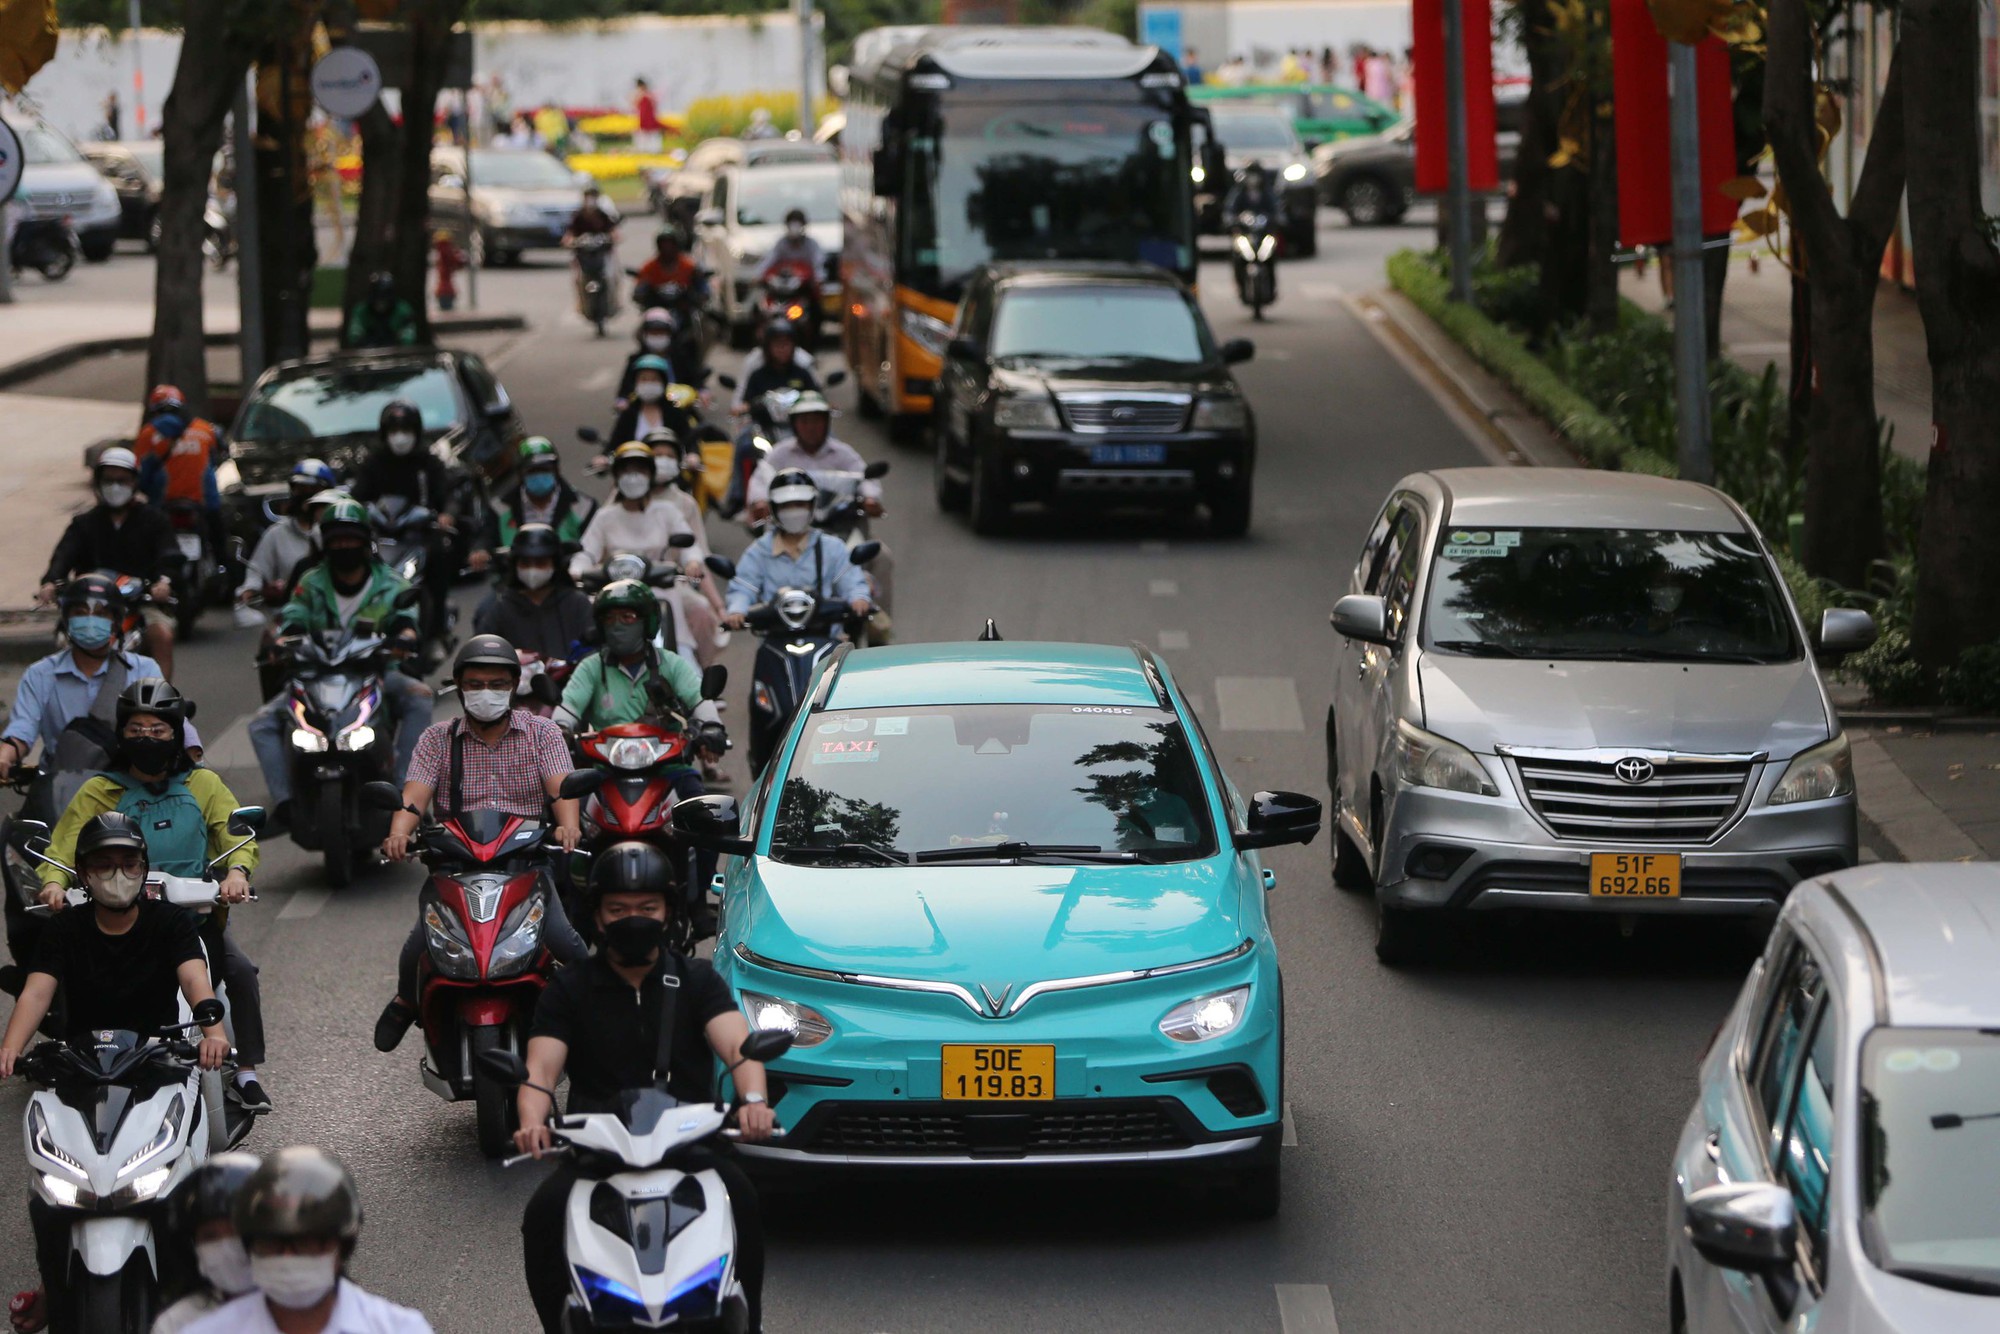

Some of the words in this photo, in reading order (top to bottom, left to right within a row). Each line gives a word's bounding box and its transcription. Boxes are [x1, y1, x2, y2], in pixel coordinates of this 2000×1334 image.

[1071, 706, 1133, 715] 04045C
[822, 741, 874, 753] TAXI
[1616, 855, 1655, 874] 51F
[1600, 876, 1671, 895] 692.66
[974, 1048, 1022, 1072] 50E
[957, 1074, 1042, 1098] 119.83
